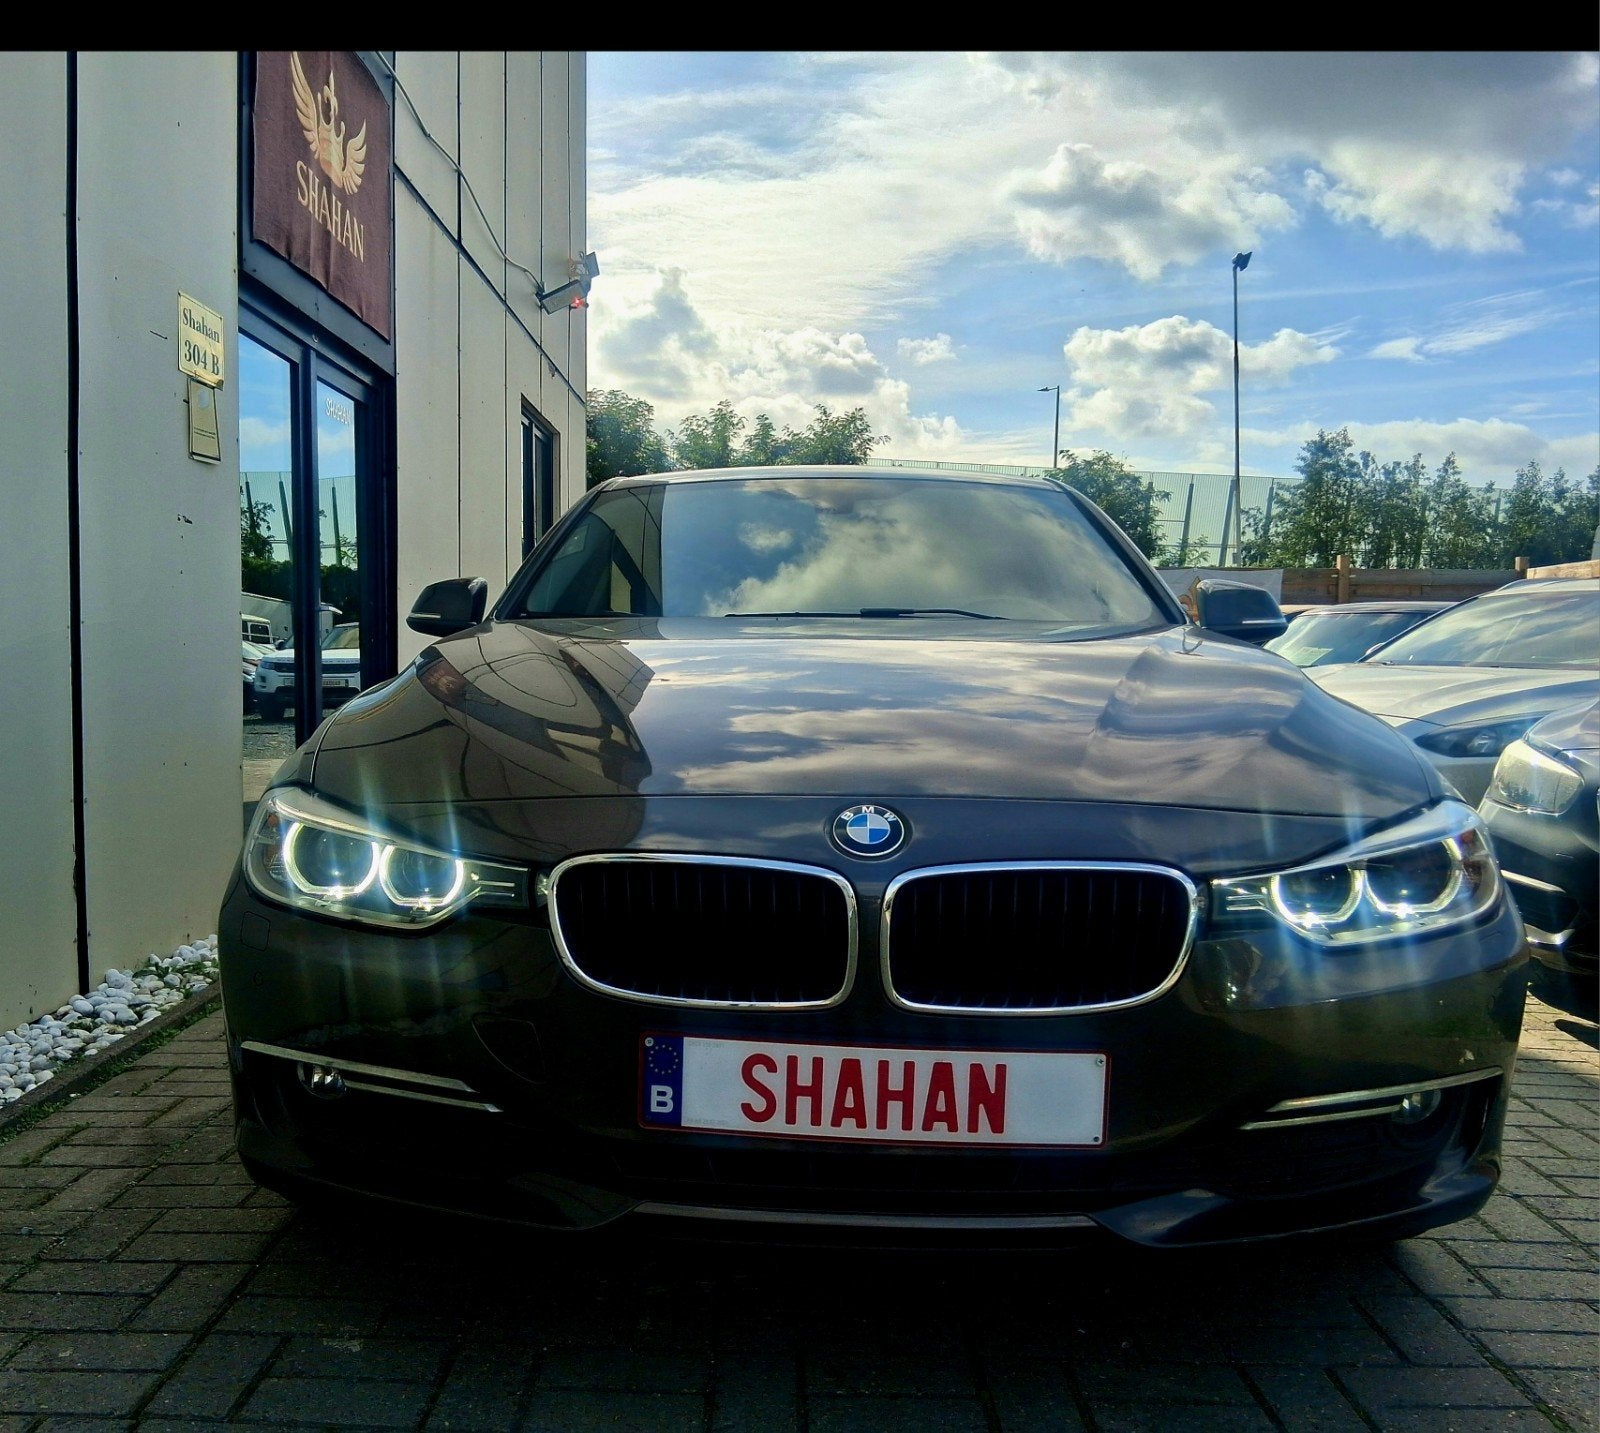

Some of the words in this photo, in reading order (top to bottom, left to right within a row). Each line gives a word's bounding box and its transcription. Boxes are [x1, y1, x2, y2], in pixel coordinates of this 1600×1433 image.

[296, 160, 364, 263] SHAHAN
[182, 307, 220, 344] Shahan
[184, 339, 208, 370] 304
[211, 351, 220, 376] B
[840, 805, 898, 822] BMW
[650, 1086, 674, 1114] B
[740, 1053, 1007, 1134] SHAHAN
